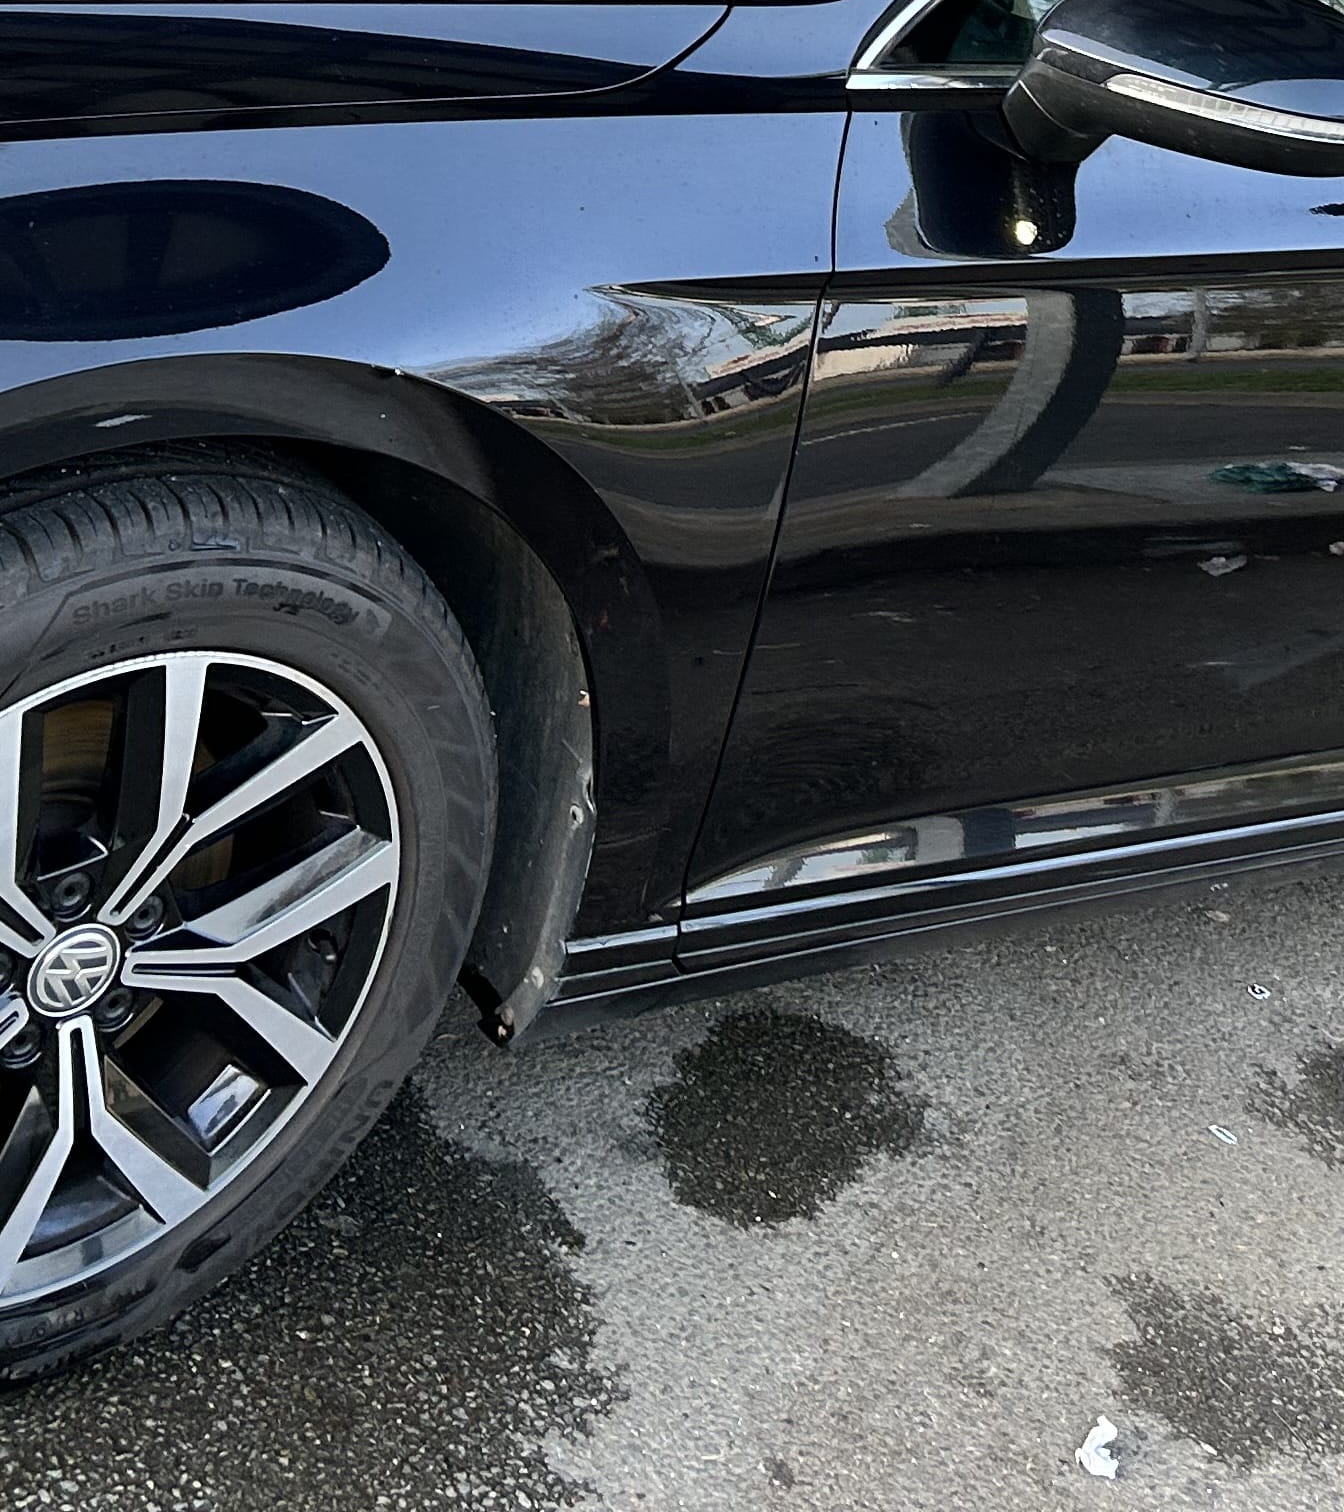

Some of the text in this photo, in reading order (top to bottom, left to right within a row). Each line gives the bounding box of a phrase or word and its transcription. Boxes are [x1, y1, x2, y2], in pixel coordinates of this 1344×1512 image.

[71, 577, 360, 626] Shark Skin Technology
